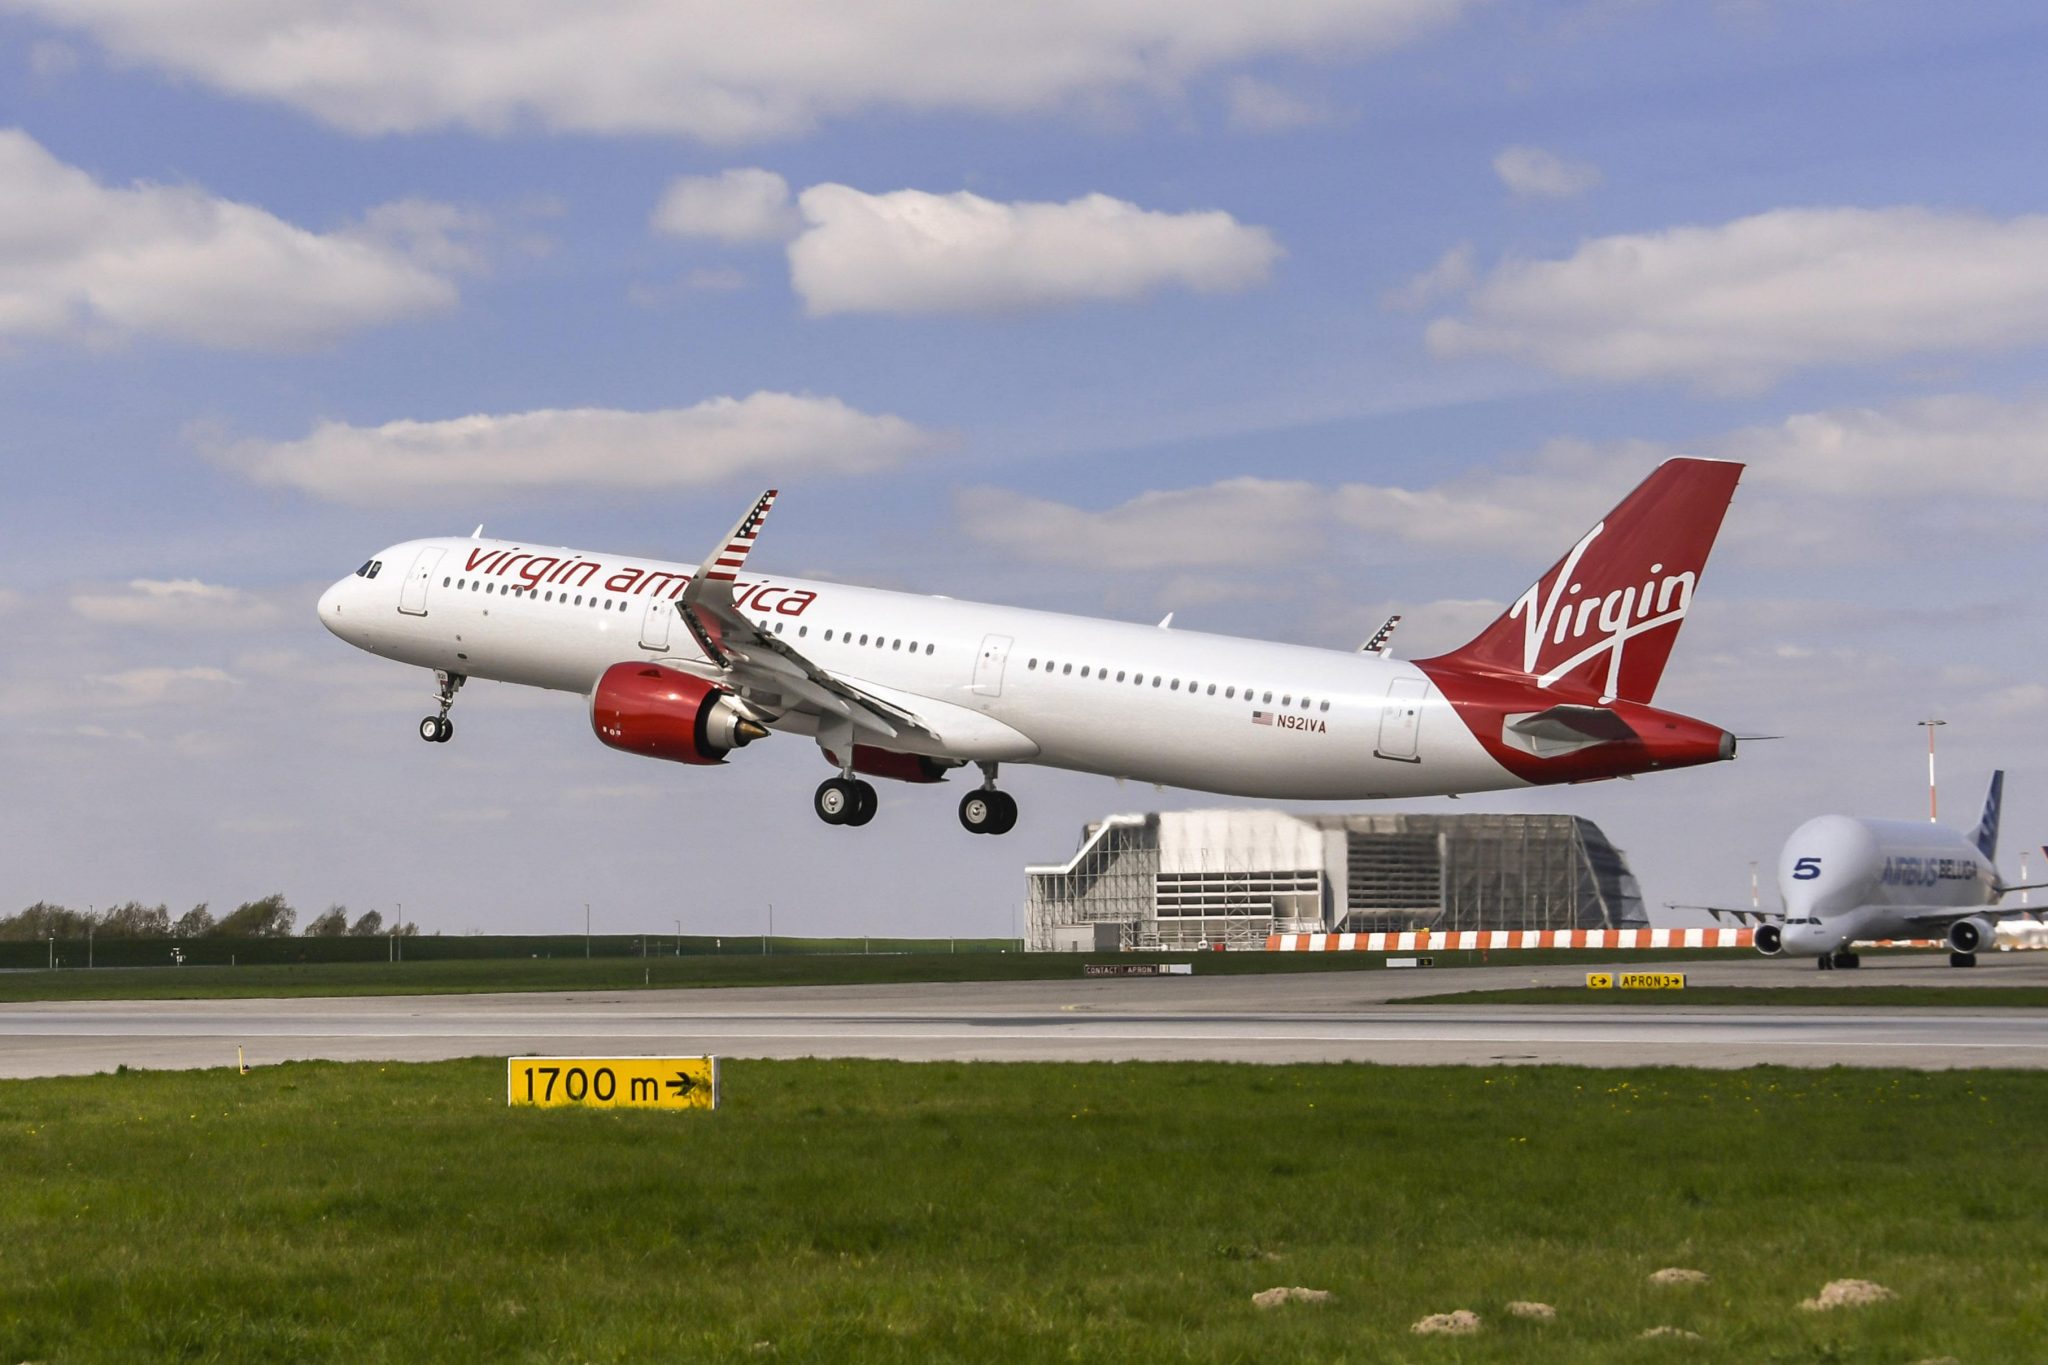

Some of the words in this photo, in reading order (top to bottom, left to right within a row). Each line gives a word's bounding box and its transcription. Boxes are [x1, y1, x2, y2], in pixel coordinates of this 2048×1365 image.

[465, 547, 602, 592] virgin
[1509, 521, 1696, 705] Virgin
[1277, 714, 1326, 734] N921VA
[1792, 857, 1822, 880] 5
[1880, 856, 1938, 887] AIRBUS
[1938, 858, 1977, 880] BELUGA
[1086, 966, 1118, 975] CONTACT
[1127, 966, 1153, 974] APRON
[1590, 976, 1598, 987] C
[1622, 975, 1662, 987] APRON
[1663, 975, 1671, 987] 3
[525, 1067, 617, 1102] 1700
[630, 1077, 659, 1101] m
